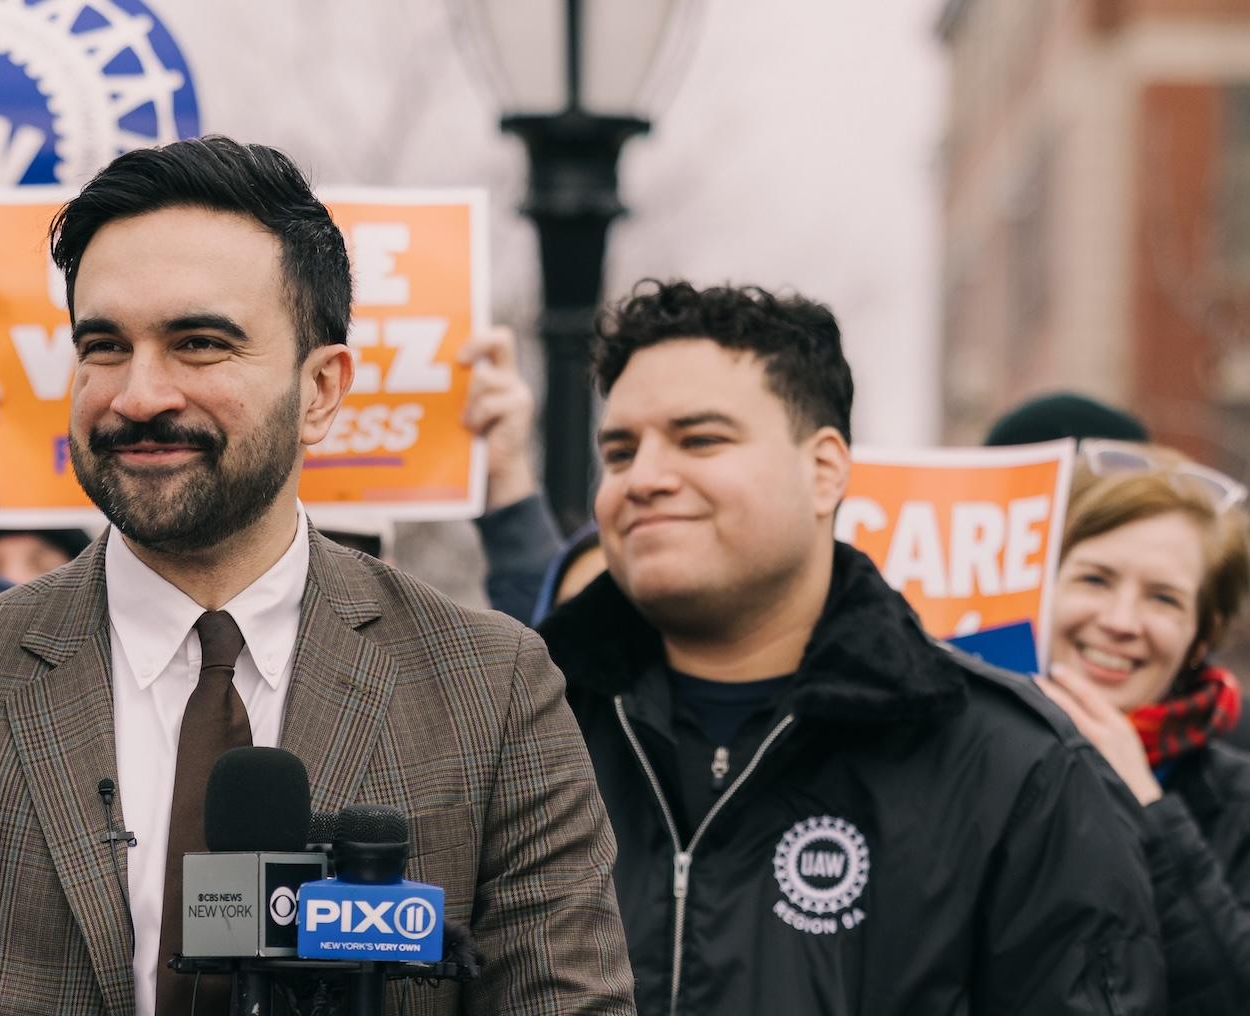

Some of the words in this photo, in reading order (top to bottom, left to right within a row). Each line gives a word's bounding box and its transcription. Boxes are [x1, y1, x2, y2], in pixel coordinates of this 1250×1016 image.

[801, 850, 846, 878] UAW
[204, 893, 219, 902] CBS
[219, 893, 243, 902] NEWS
[188, 904, 217, 918] NEW
[219, 904, 253, 918] YORK
[306, 899, 395, 935] PIX
[773, 900, 838, 934] REGION
[320, 942, 341, 951] NEW
[340, 942, 374, 951] YORK'S
[374, 943, 398, 952] VERY
[398, 943, 421, 952] OWN
